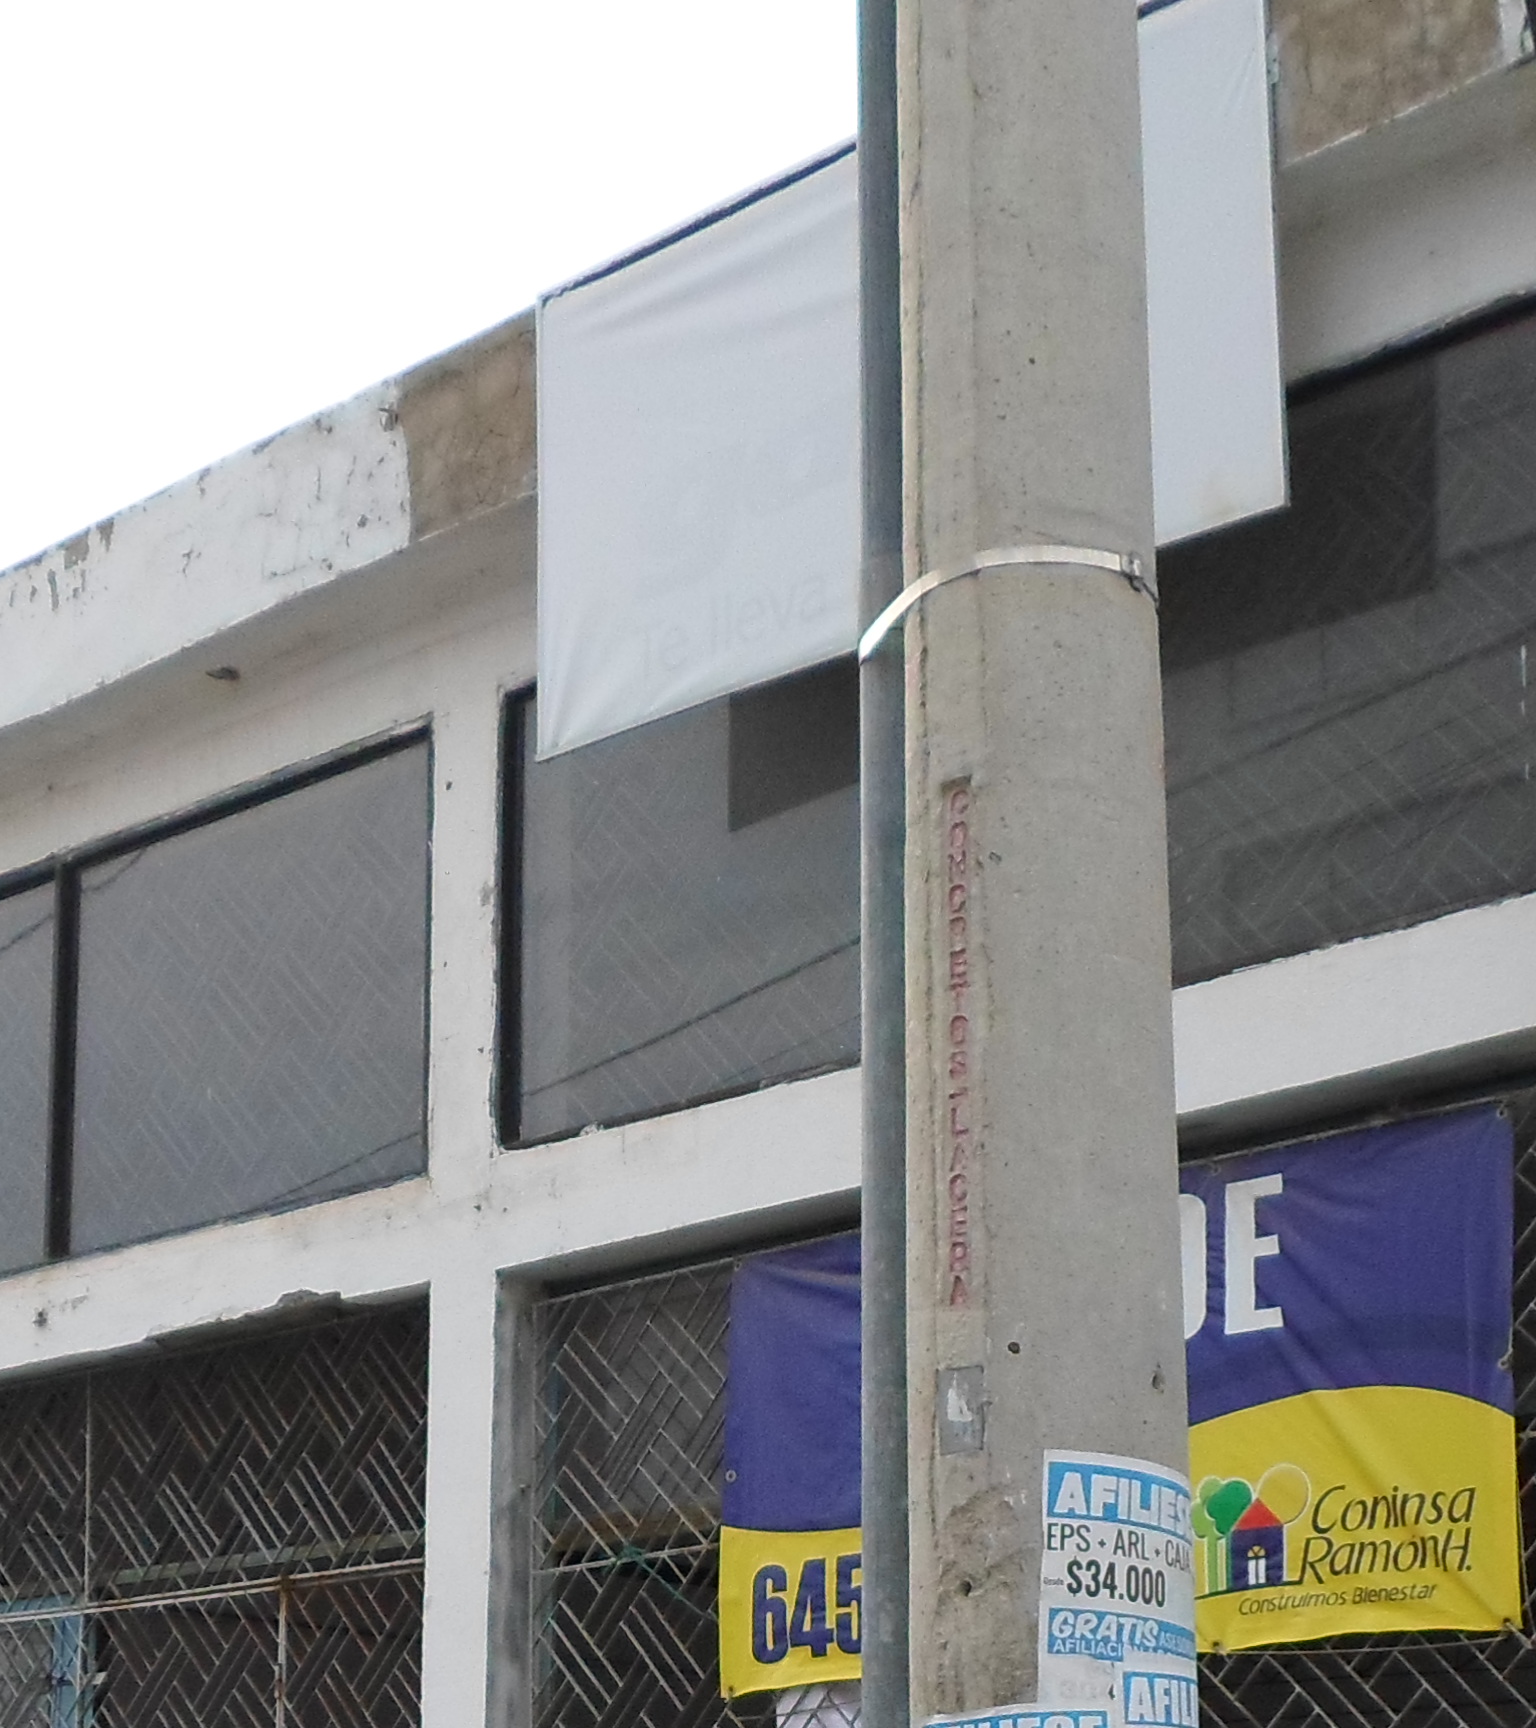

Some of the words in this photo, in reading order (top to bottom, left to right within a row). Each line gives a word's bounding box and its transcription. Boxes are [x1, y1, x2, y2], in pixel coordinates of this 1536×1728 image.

[1312, 1484, 1476, 1535] Coninsa
[1047, 1522, 1091, 1552] EPS
[1113, 1529, 1149, 1561] ARL
[1067, 1556, 1165, 1608] $34.000
[1238, 1588, 1348, 1616] Construimos
[1352, 1582, 1438, 1605] Bienestar
[1051, 1611, 1159, 1647] GRATIS
